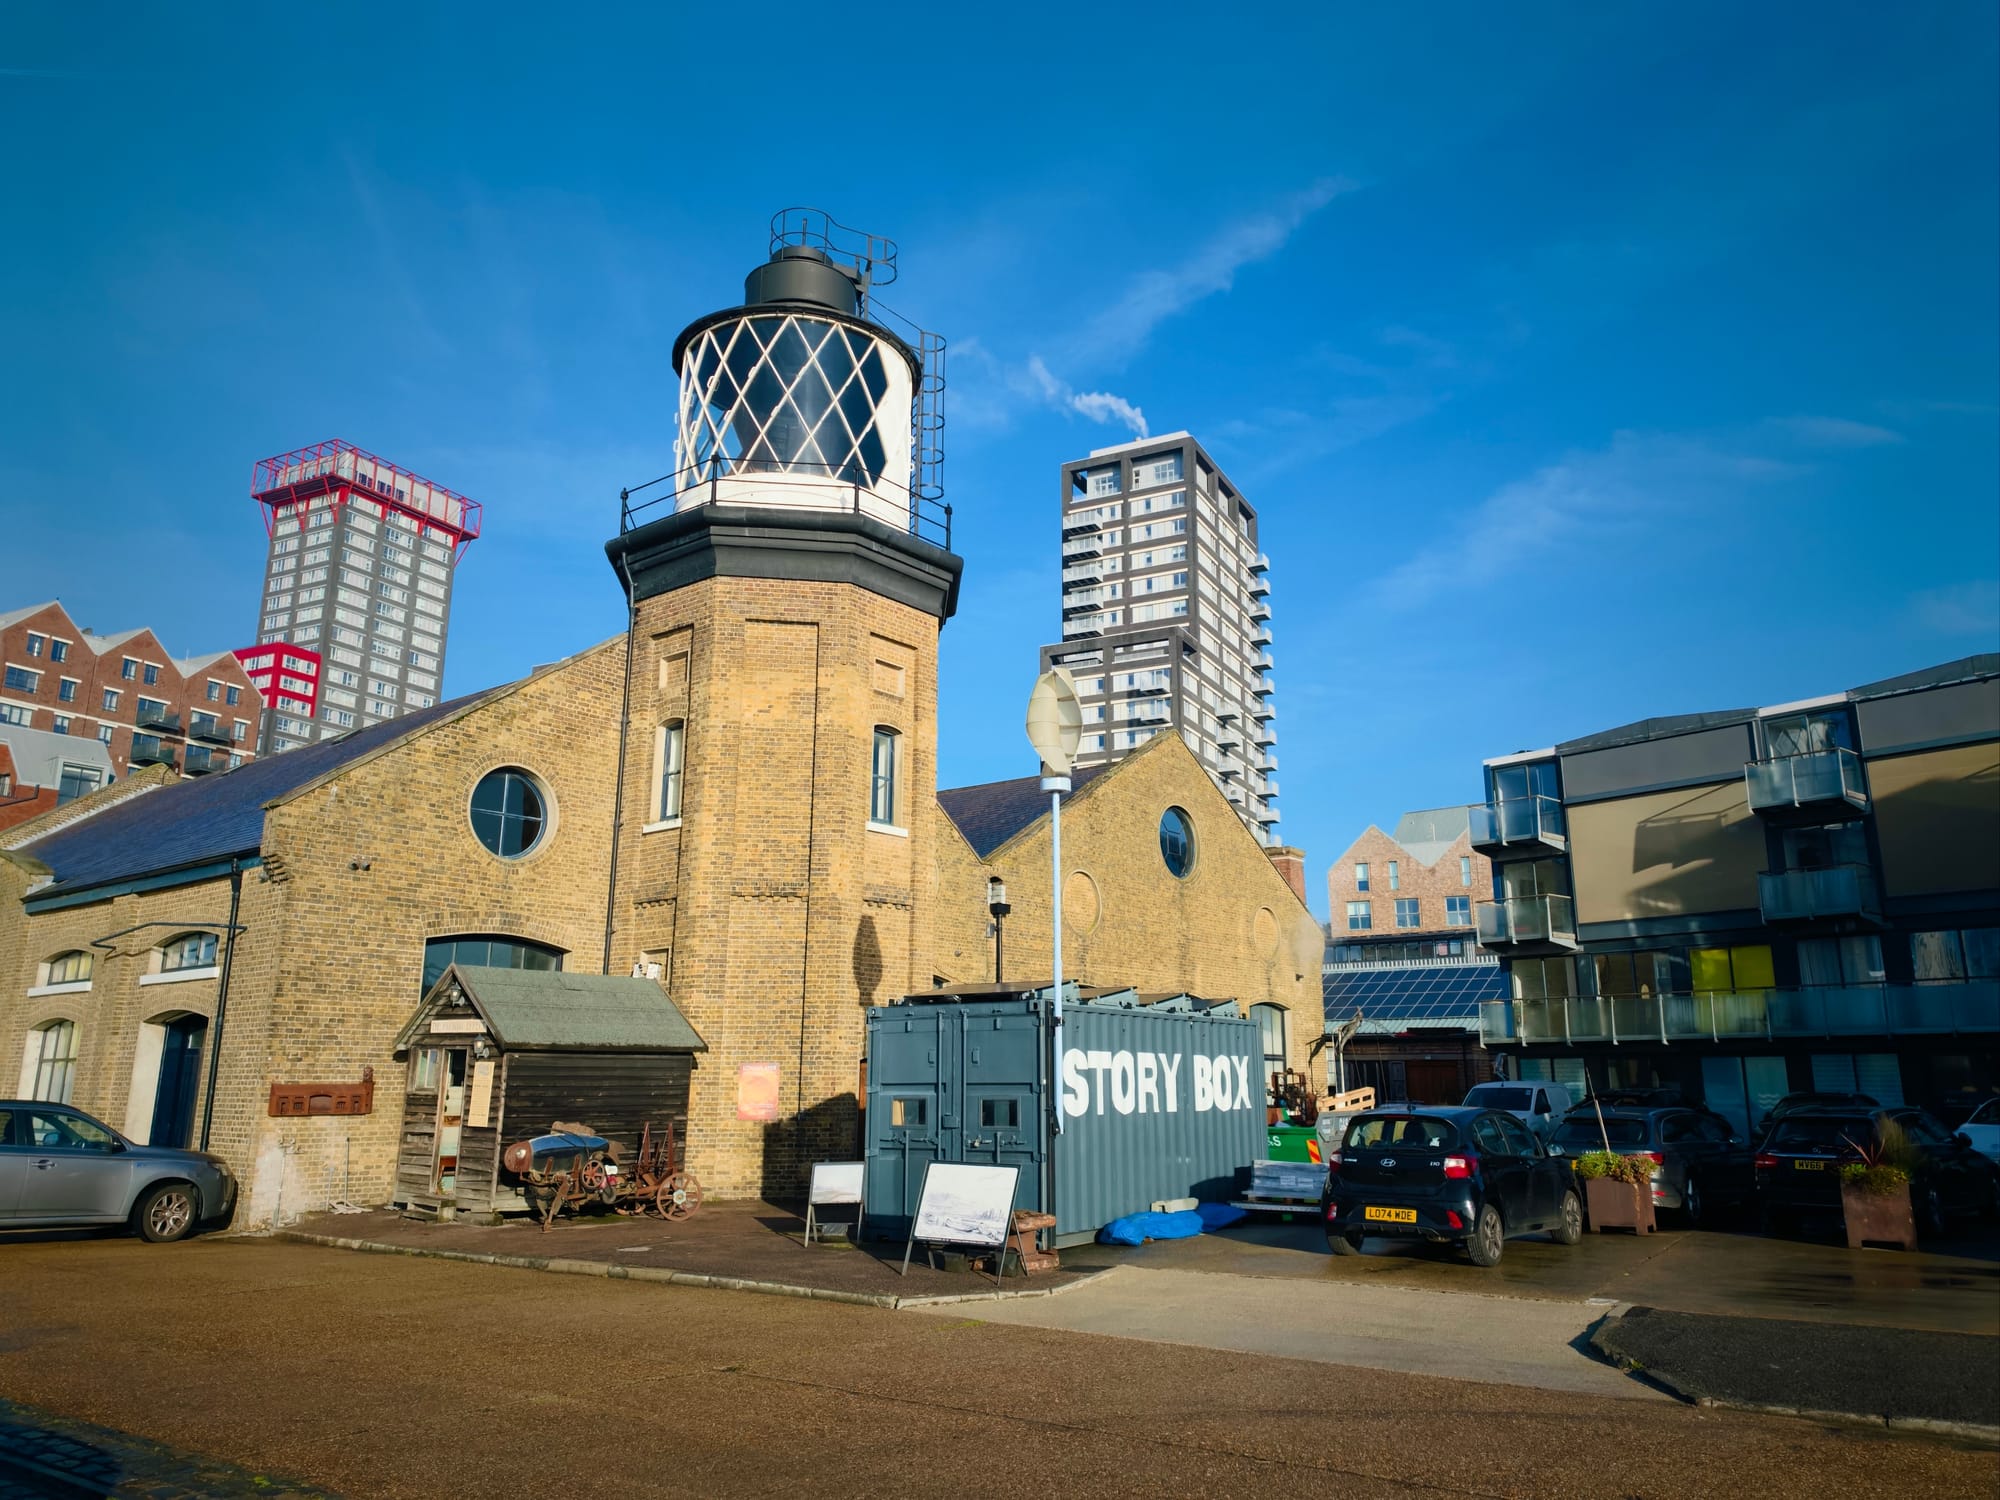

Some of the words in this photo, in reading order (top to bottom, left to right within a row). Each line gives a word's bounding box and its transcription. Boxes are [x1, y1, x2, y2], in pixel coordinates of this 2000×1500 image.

[1063, 1048, 1182, 1117] STORY
[1193, 1054, 1252, 1112] BOX
[1369, 1208, 1392, 1219] LO74
